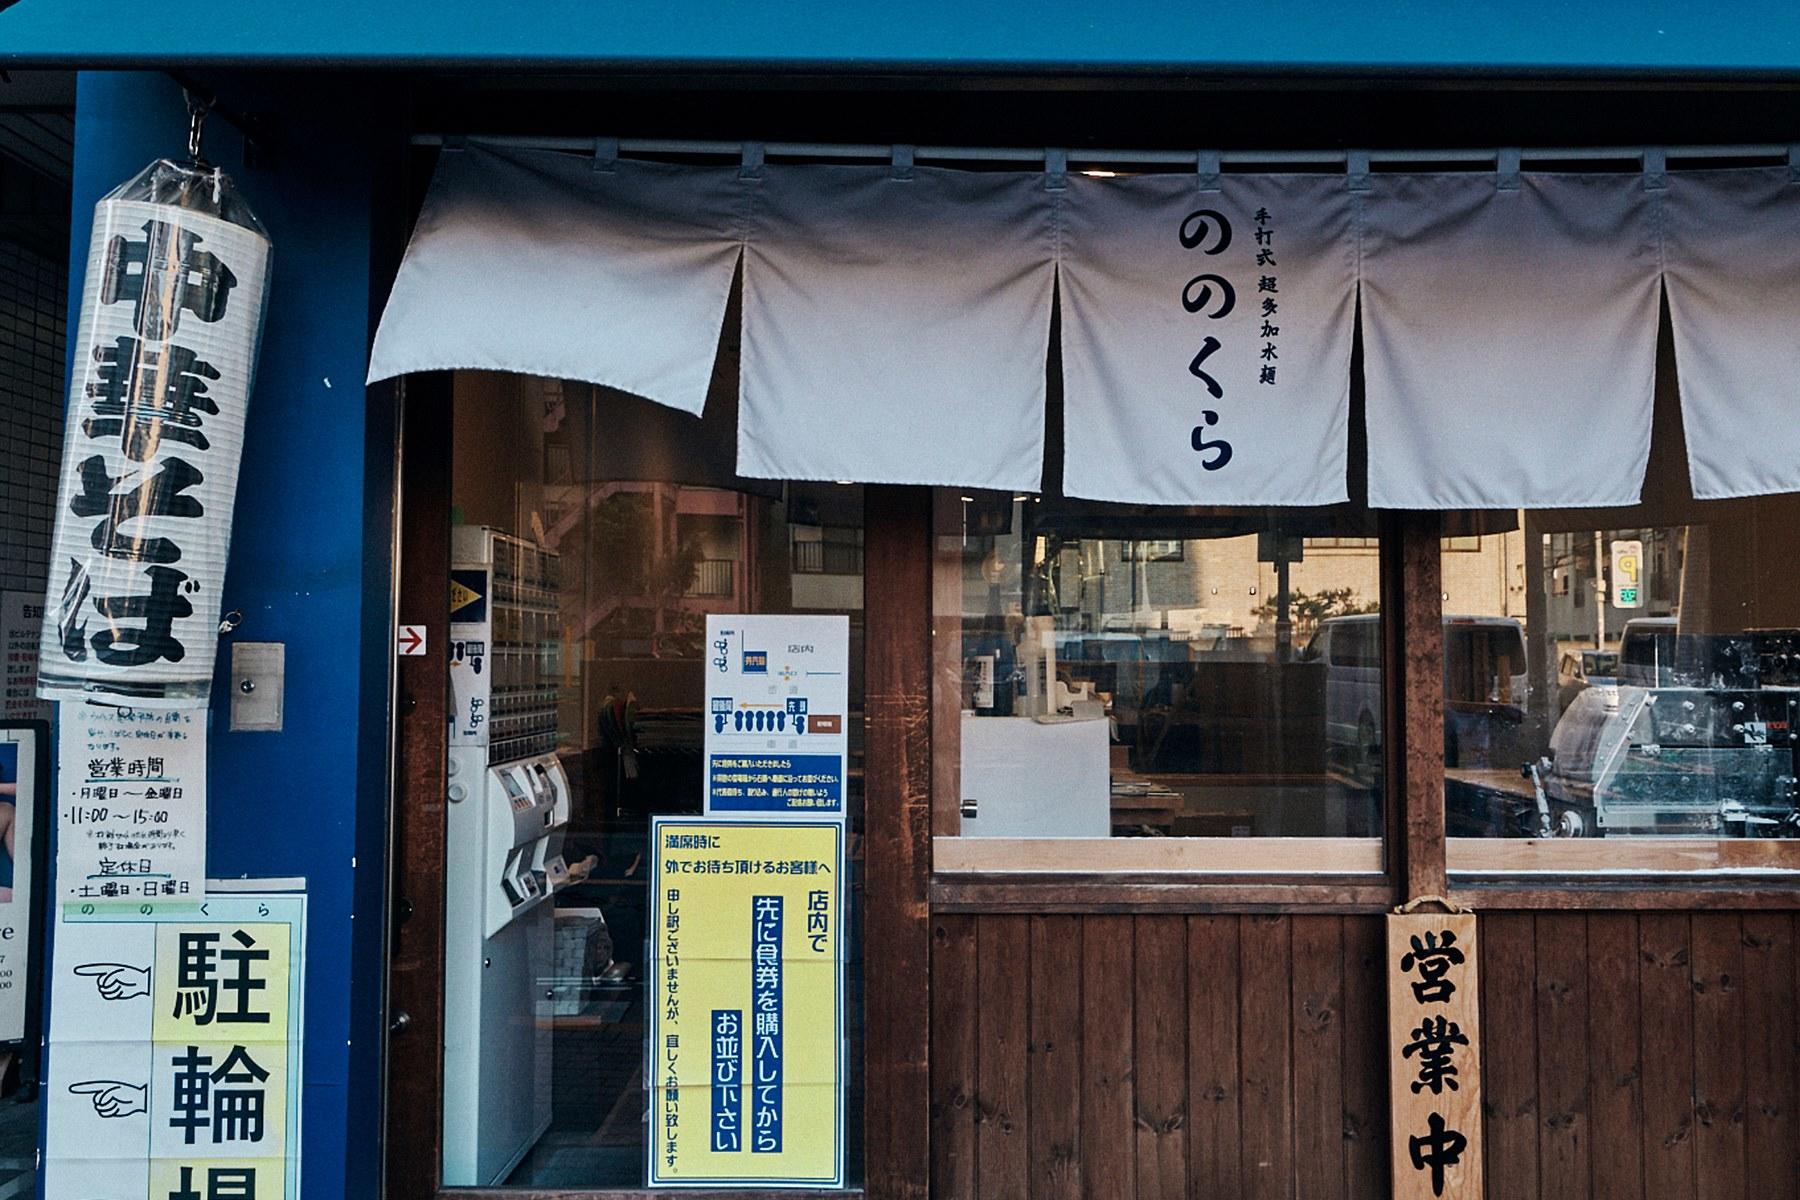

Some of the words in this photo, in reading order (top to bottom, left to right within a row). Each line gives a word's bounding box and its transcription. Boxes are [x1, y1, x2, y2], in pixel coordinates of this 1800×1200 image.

[1254, 207, 1277, 267] 手打式
[1179, 209, 1237, 472] ののくら
[1258, 275, 1280, 386] 超多加水麺
[59, 220, 237, 665] 中華そば
[88, 757, 165, 779] 営業時間
[99, 857, 152, 876] 定休日
[665, 834, 721, 850] 満席時に
[665, 859, 832, 875] 外でお待ち頂けるお客様へ
[807, 889, 829, 953] 店内で
[756, 897, 779, 1151] 先に食券を購入してから
[1400, 930, 1470, 1198] 営業中
[716, 1012, 739, 1150] お並び下さい
